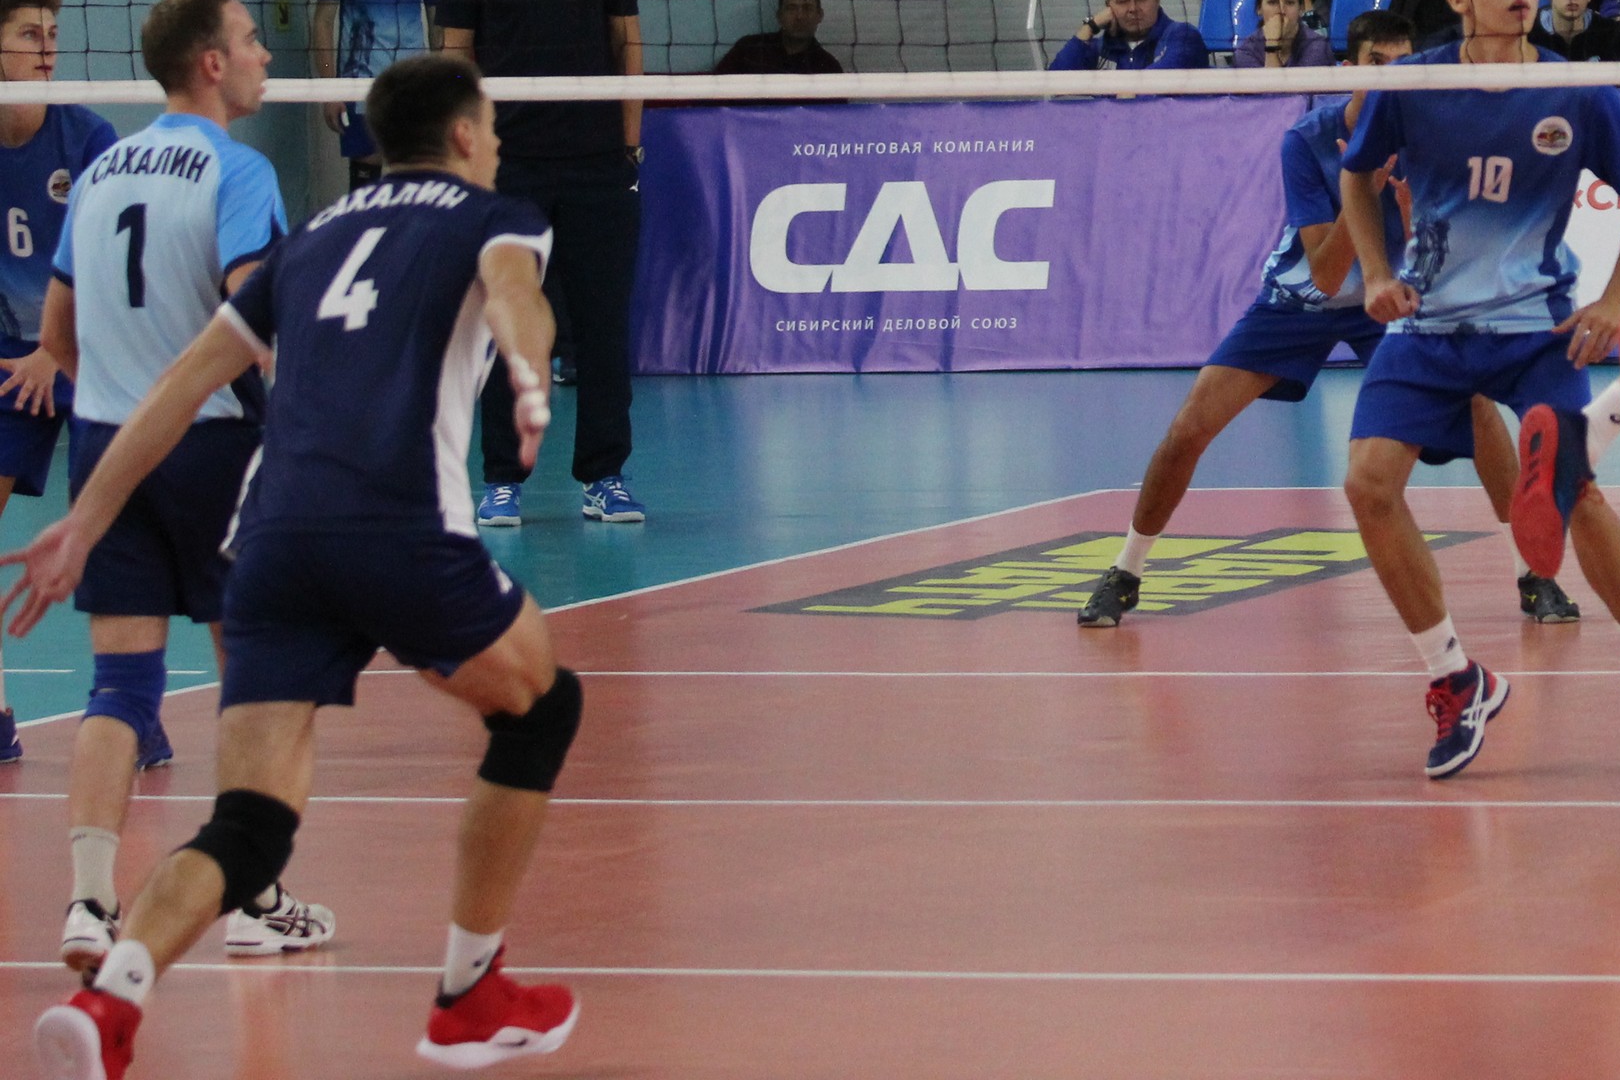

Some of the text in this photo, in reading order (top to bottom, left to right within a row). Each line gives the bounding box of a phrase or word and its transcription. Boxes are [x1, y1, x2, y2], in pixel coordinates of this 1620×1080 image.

[91, 145, 211, 185] САХАЛИН
[793, 139, 1035, 158] ХОЛДИНГОВАЯ КОМПАНИЯ
[1467, 156, 1513, 204] 10
[307, 180, 469, 232] САХАЛИН
[7, 207, 34, 258] 6
[115, 203, 148, 308] 1
[316, 227, 387, 332] 4
[776, 315, 1018, 332] СИБИРСКИЙ ДЕЛОВОЙ СОЮЗ
